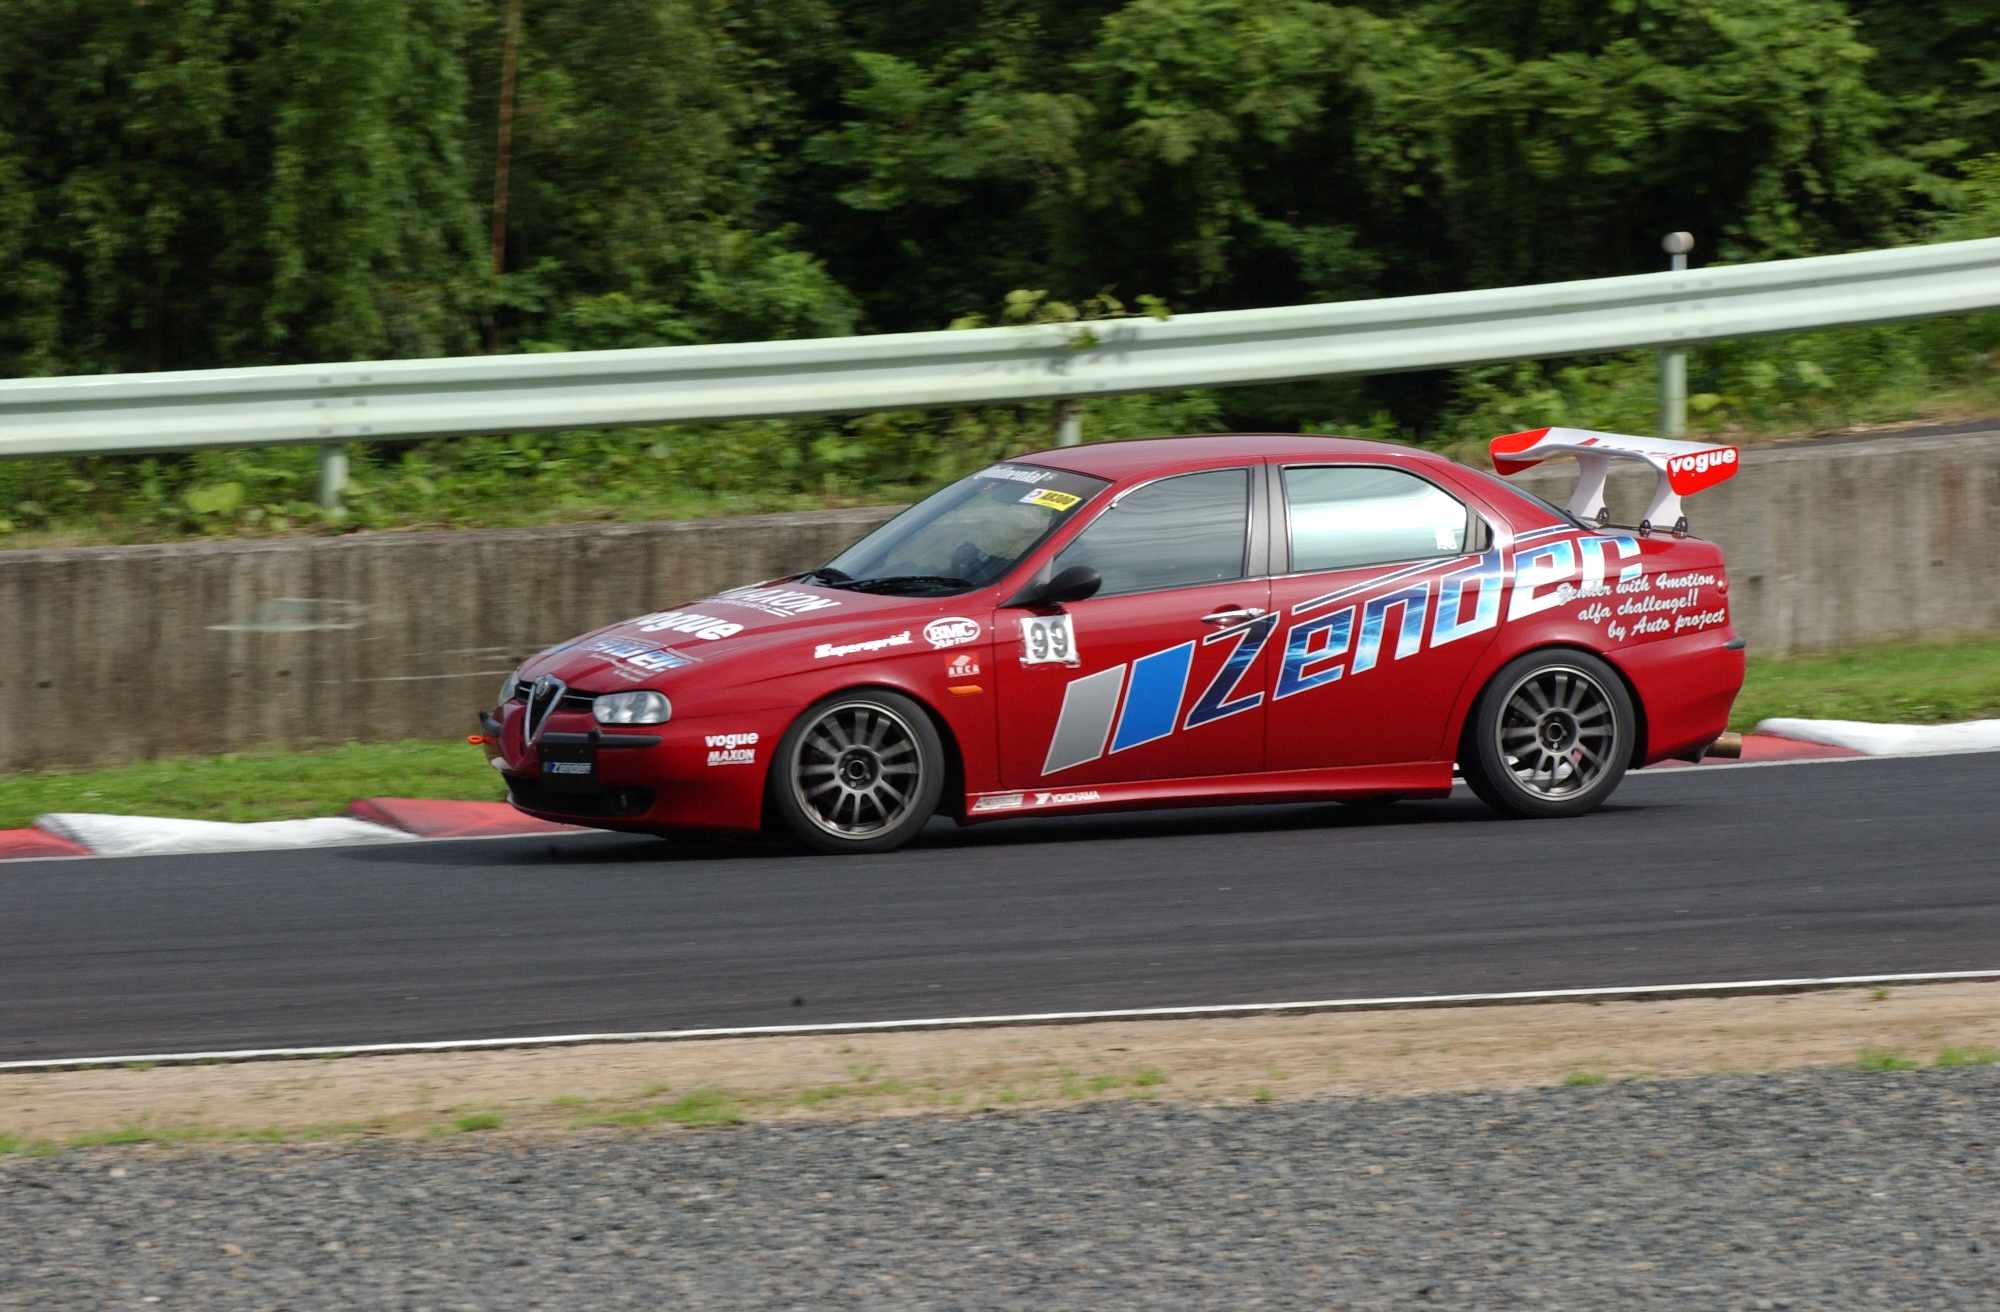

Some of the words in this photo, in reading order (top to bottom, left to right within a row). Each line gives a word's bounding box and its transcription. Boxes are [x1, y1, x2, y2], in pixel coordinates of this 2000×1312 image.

[1669, 448, 1737, 475] vogue
[1616, 574, 1651, 595] with
[1655, 572, 1716, 591] 4motion
[1577, 602, 1613, 625] alfa
[1617, 588, 1699, 617] challenge!!
[928, 622, 978, 641] BMC
[1184, 535, 1645, 731] Zender
[1607, 620, 1627, 642] by
[1630, 616, 1672, 637] Auto
[1674, 608, 1726, 634] project
[1030, 621, 1070, 660] 99
[704, 732, 759, 749] vogue
[706, 749, 756, 763] MAXON
